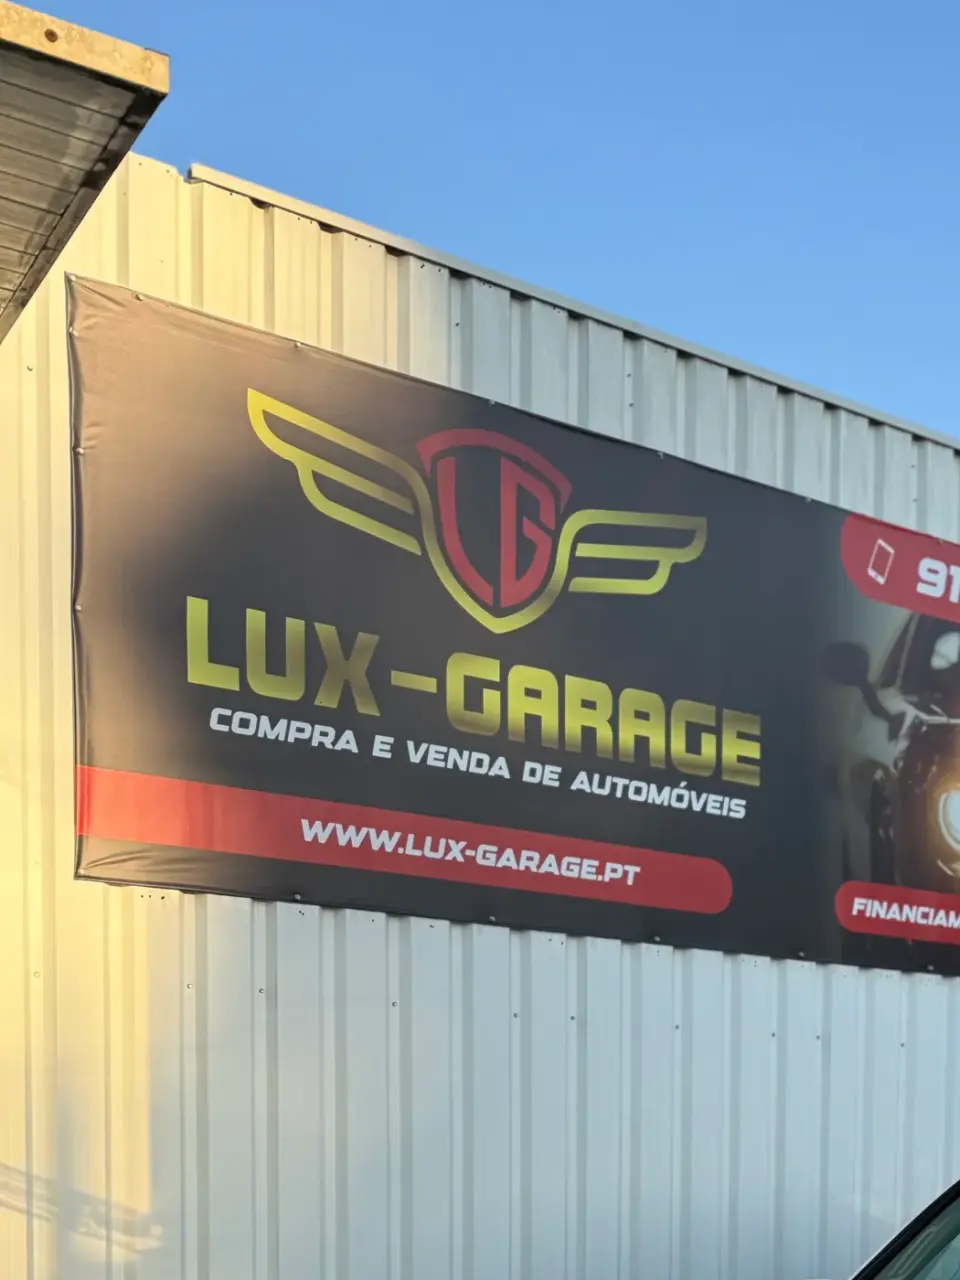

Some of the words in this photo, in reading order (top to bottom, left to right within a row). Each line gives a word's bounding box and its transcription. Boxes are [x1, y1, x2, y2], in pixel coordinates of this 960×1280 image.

[186, 595, 761, 786] LUX-GARAGE
[209, 708, 359, 754] COMPRA
[372, 736, 394, 759] E
[406, 742, 510, 779] VENDA
[522, 762, 561, 787] DE
[570, 770, 747, 819] AUTOMÓVEIS
[300, 819, 641, 886] WWW.LUX-GARAGE.PT
